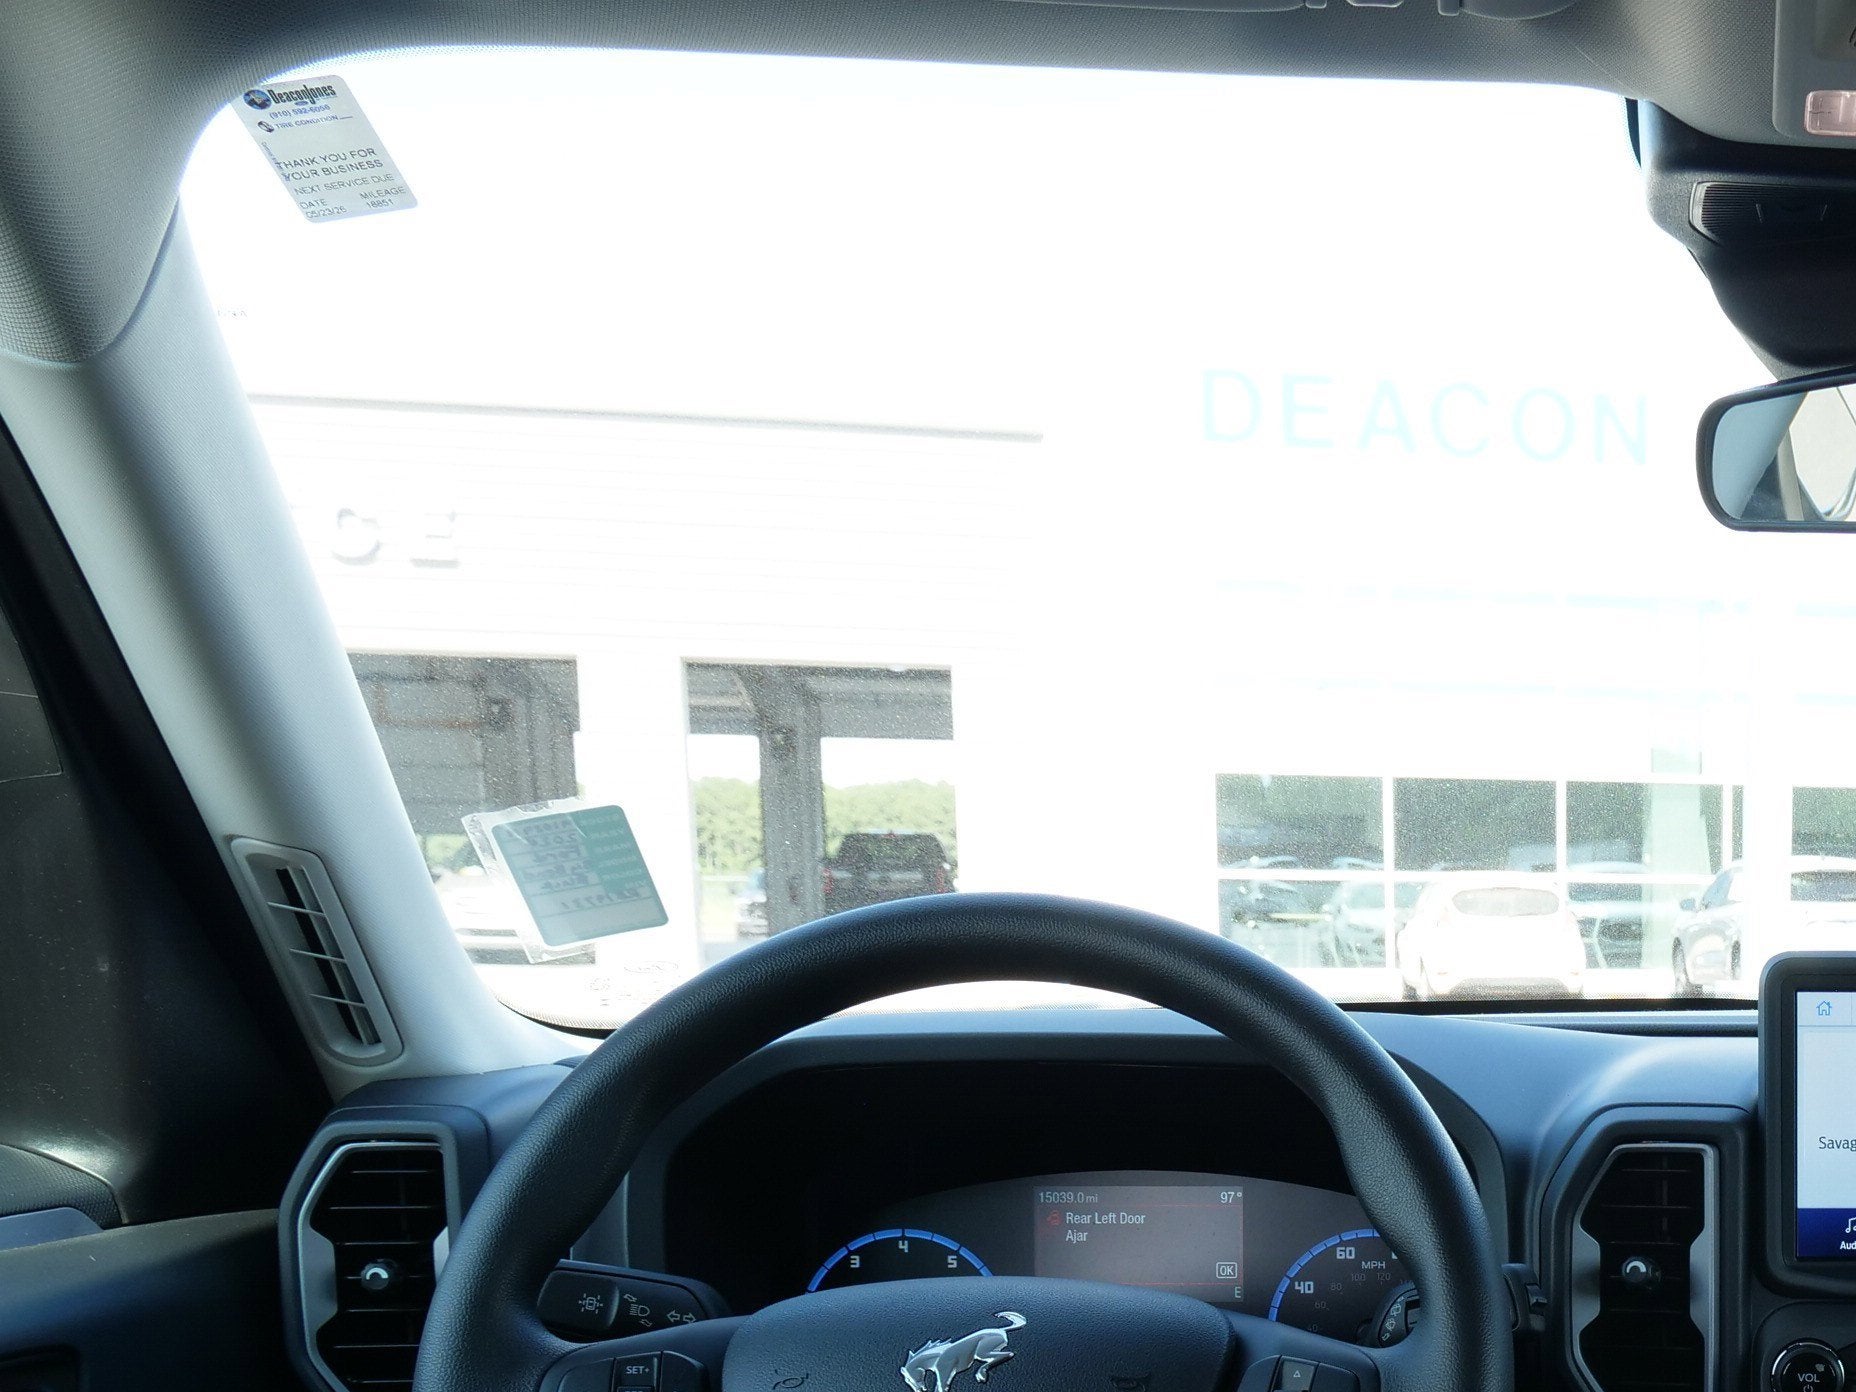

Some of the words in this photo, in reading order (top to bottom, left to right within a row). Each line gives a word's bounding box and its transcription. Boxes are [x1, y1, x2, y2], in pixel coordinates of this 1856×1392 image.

[275, 156, 320, 171] THANK
[319, 152, 348, 163] YOU
[349, 147, 378, 159] FOR
[281, 169, 320, 182] YOUR
[321, 159, 384, 176] BUSINESS
[293, 184, 321, 196] NEXT
[323, 177, 370, 191] SERVICE
[371, 173, 395, 184] DUE
[359, 187, 407, 200] MILEAGE
[300, 198, 328, 210] DATE
[1201, 368, 1650, 466] DEACON
[1220, 1191, 1243, 1204] 97°
[1065, 1212, 1092, 1225] Rear
[1094, 1212, 1117, 1225] Left
[1119, 1212, 1146, 1225] Door
[1065, 1229, 1088, 1244] Ajar
[898, 1240, 909, 1253] 4
[1336, 1246, 1356, 1259] 60
[850, 1255, 860, 1268] 3
[947, 1255, 958, 1268] 5
[1361, 1260, 1386, 1270] MPH
[1219, 1265, 1234, 1276] OK
[1351, 1273, 1366, 1281] 100
[1376, 1272, 1391, 1281] 120
[1234, 1286, 1242, 1299] E
[1294, 1281, 1314, 1294] 40
[1797, 1373, 1820, 1383] VOL
